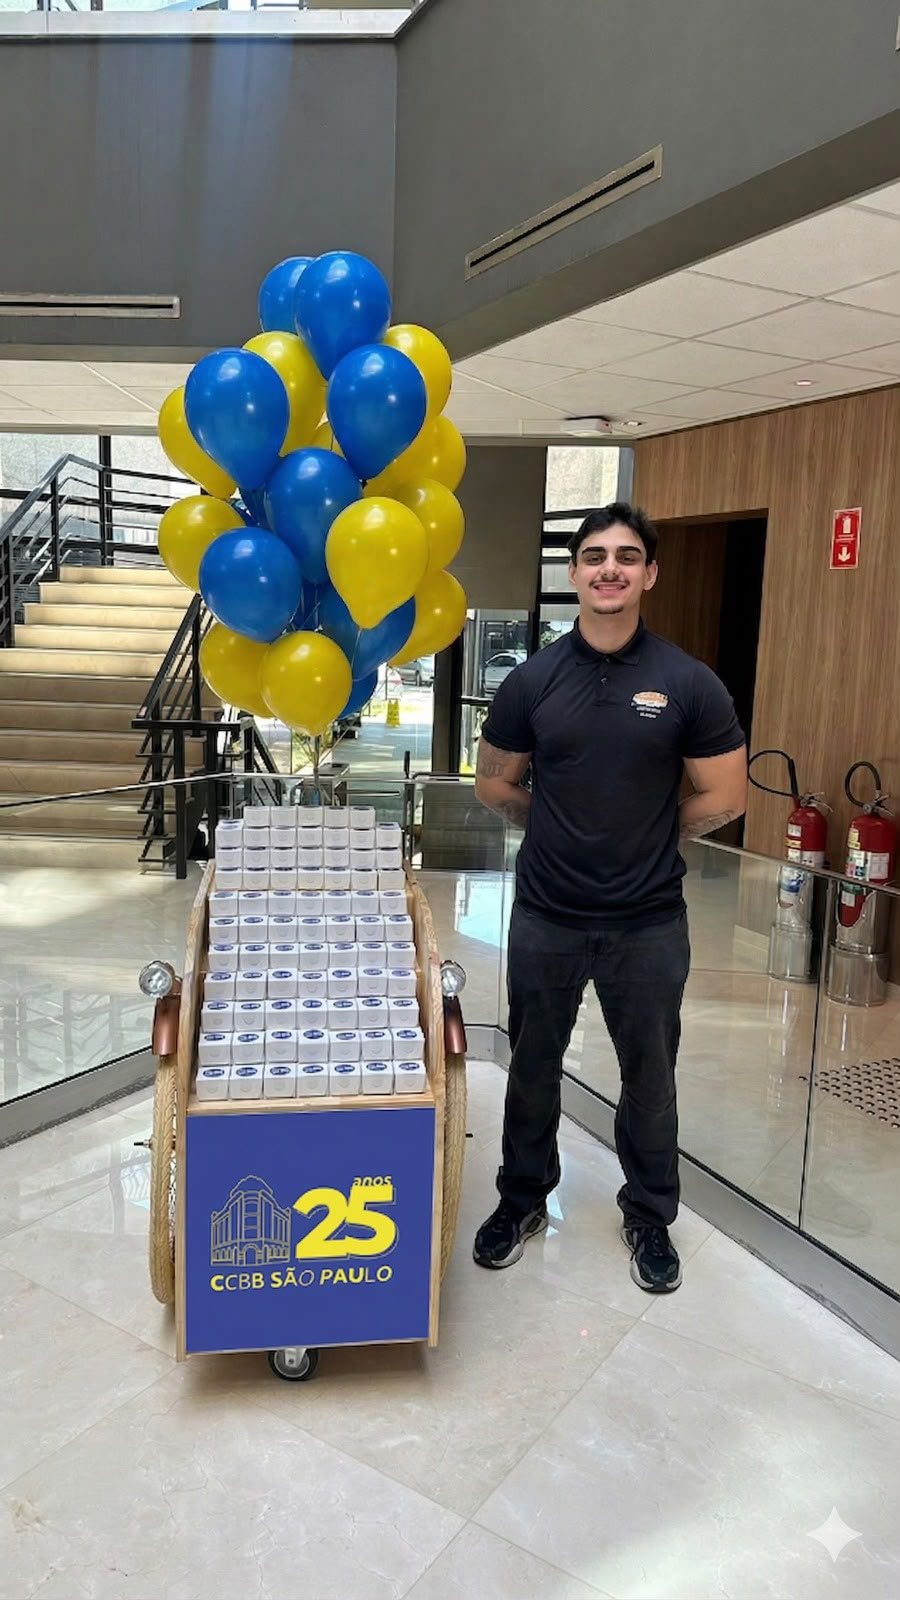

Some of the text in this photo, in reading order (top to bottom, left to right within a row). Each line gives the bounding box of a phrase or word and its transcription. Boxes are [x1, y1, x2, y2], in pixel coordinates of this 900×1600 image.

[352, 1175, 392, 1187] anos
[293, 1185, 398, 1260] 25
[209, 1265, 393, 1292] CCBB SÃO PAULO
